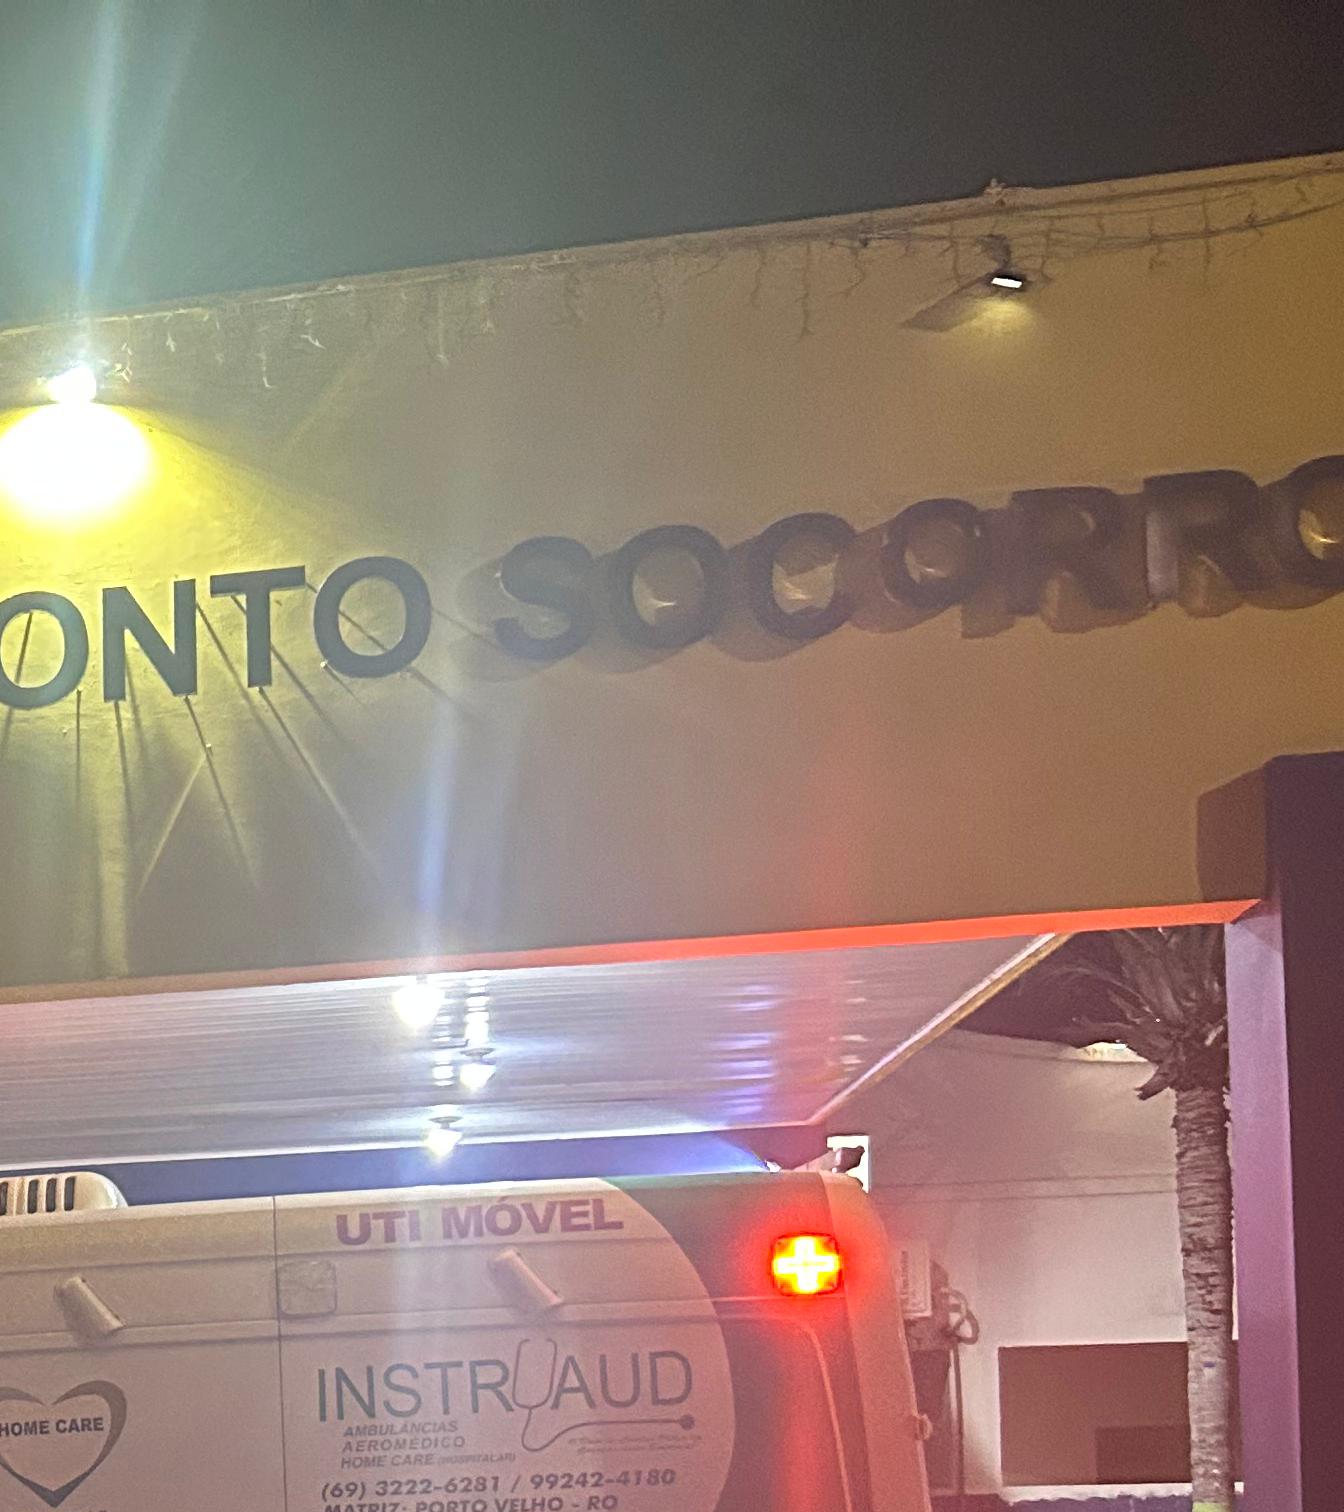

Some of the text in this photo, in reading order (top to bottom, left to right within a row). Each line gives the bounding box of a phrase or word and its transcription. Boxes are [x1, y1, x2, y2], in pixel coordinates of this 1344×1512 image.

[335, 1195, 624, 1246] UTI MÓVEL
[55, 1417, 104, 1434] CARE
[340, 1456, 386, 1469] HOME
[390, 1453, 436, 1467] CARE
[321, 1481, 367, 1502] (69)
[374, 1475, 500, 1497] 3222-6281
[530, 1468, 677, 1490] 99242-4180
[586, 1494, 619, 1511] RO
